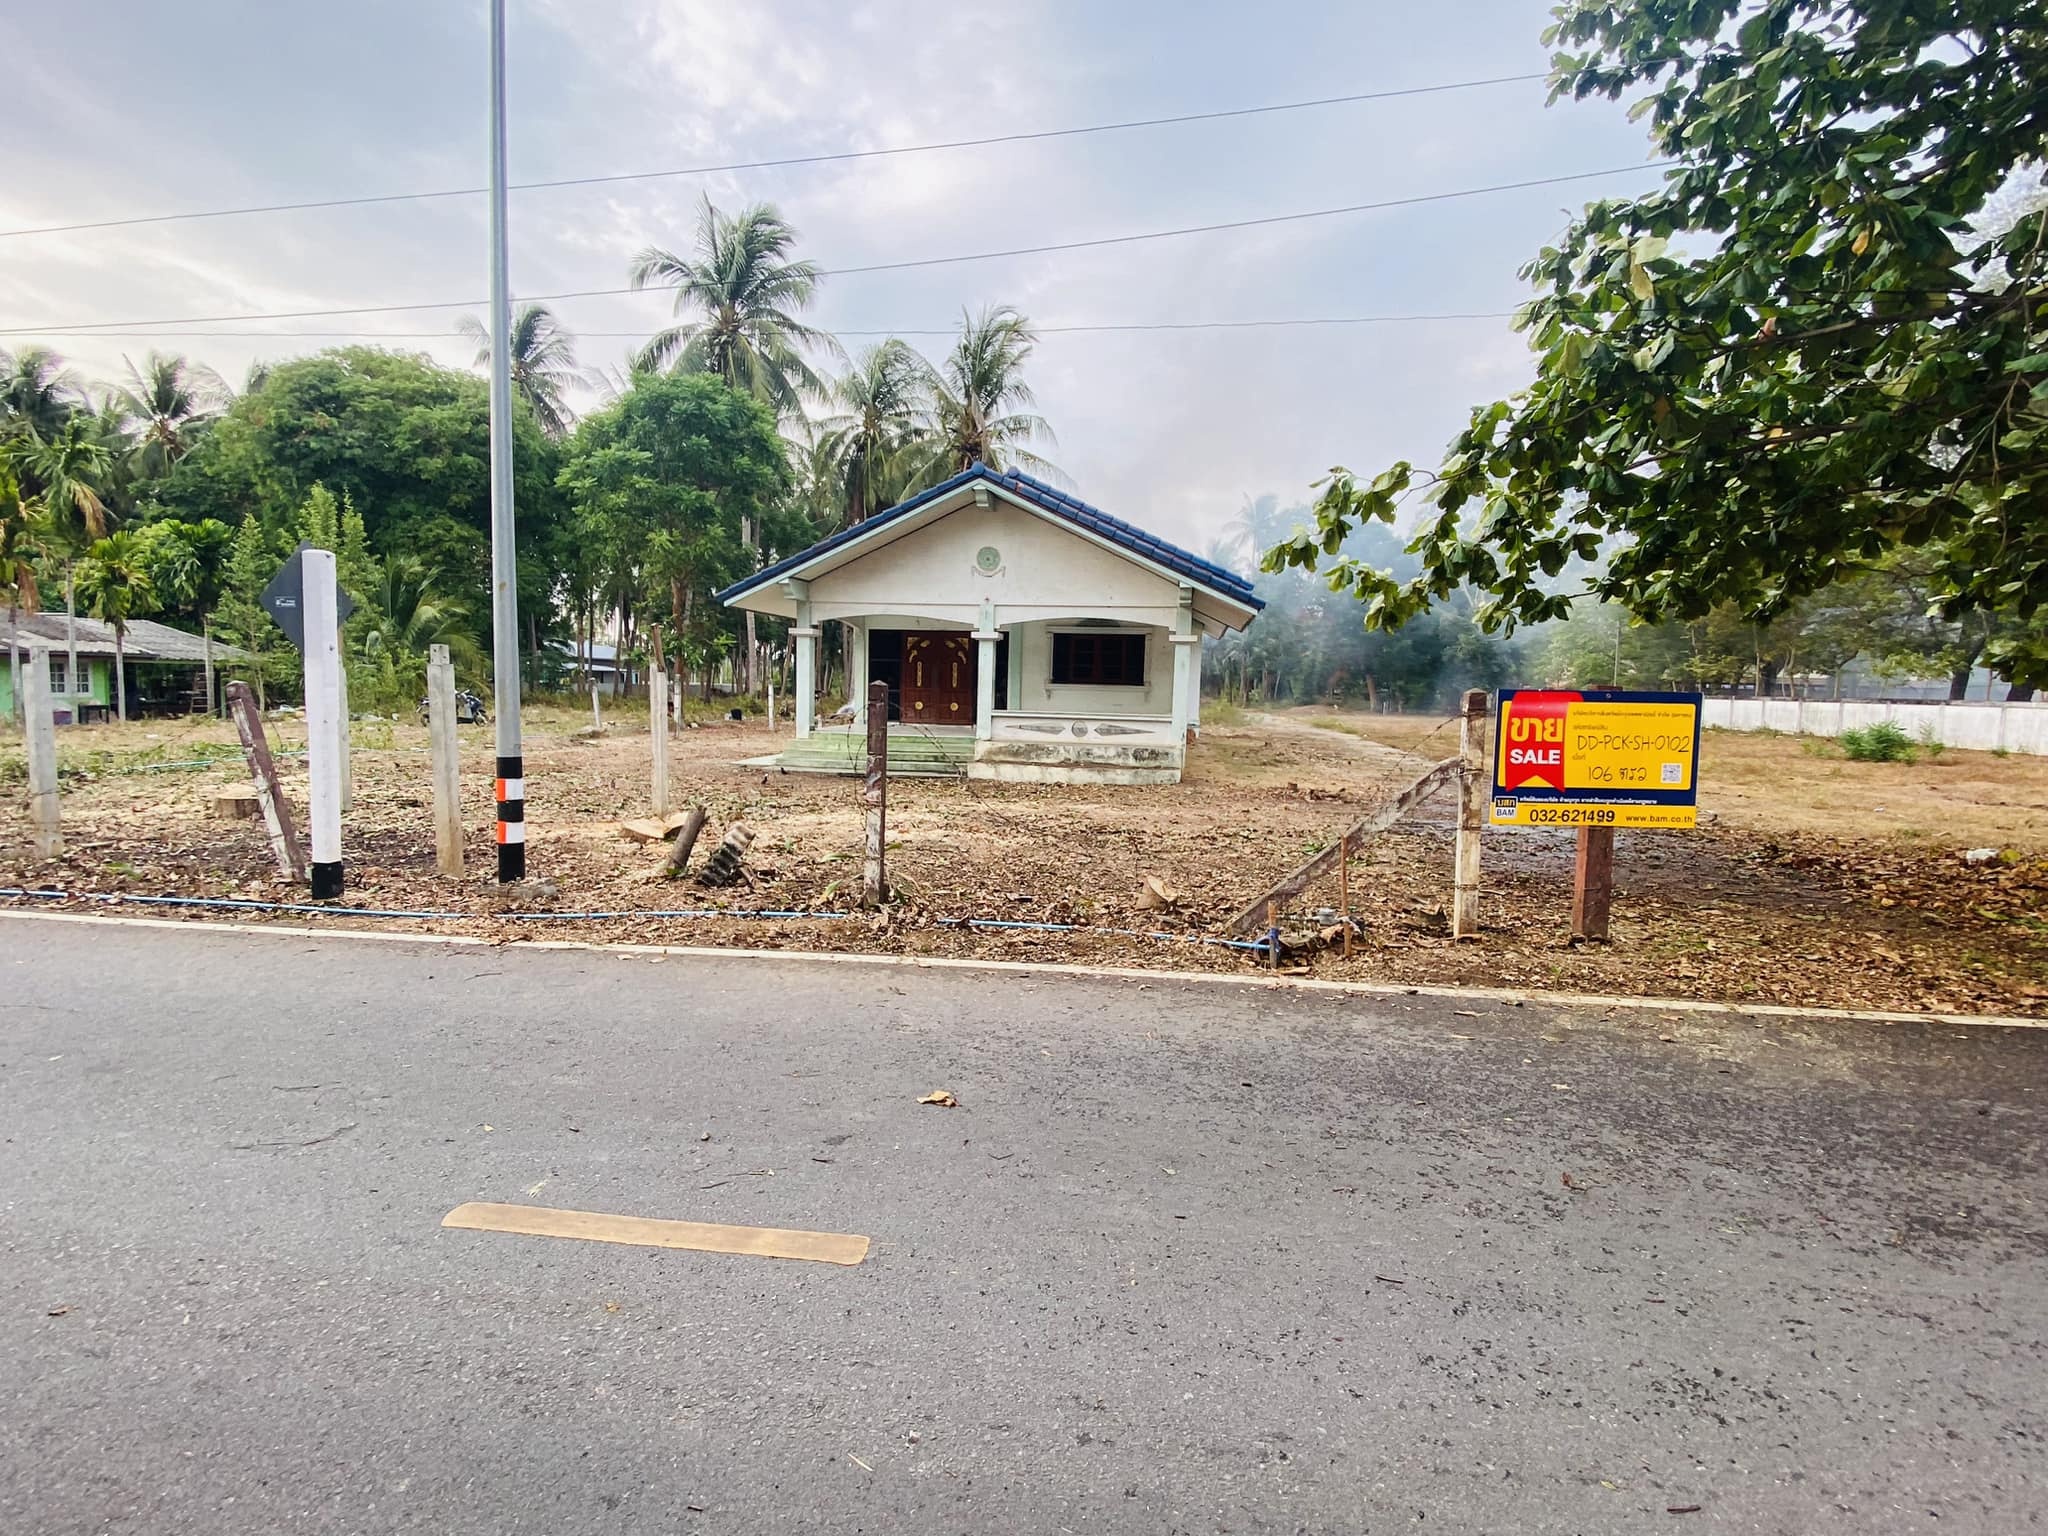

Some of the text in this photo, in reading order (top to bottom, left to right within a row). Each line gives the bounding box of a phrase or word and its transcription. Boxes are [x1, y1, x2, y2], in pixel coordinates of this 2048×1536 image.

[1510, 717, 1564, 743] ขาย
[1577, 735, 1690, 752] DD-PCK-SH-0102
[1510, 749, 1560, 764] SALE
[1588, 766, 1613, 782] 106
[1496, 809, 1515, 817] BAM
[1529, 809, 1615, 823] 032-621499
[1625, 814, 1693, 823] www.bam.co.th
